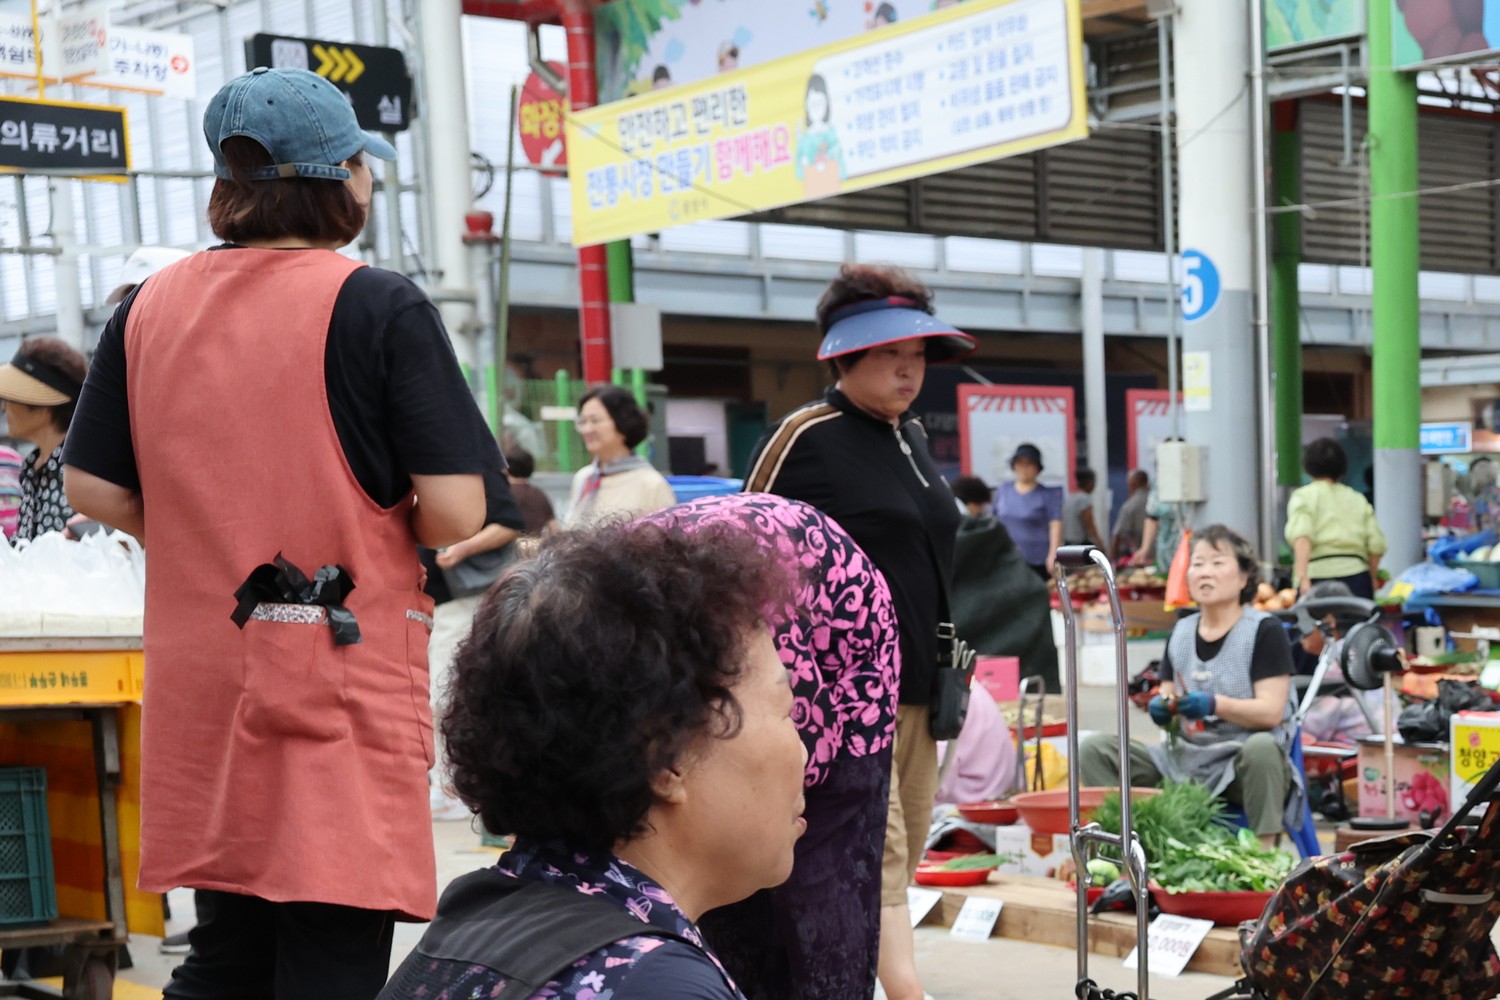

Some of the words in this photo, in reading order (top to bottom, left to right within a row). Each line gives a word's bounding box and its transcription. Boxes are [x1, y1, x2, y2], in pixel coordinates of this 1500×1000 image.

[0, 119, 119, 159] 의류거리
[519, 96, 571, 140] 화장
[617, 102, 689, 154] 안전하고
[691, 84, 749, 135] 편리한
[585, 155, 654, 210] 전통시장
[655, 142, 713, 193] 만들기
[714, 123, 793, 182] 함께해요
[1181, 255, 1205, 316] 5
